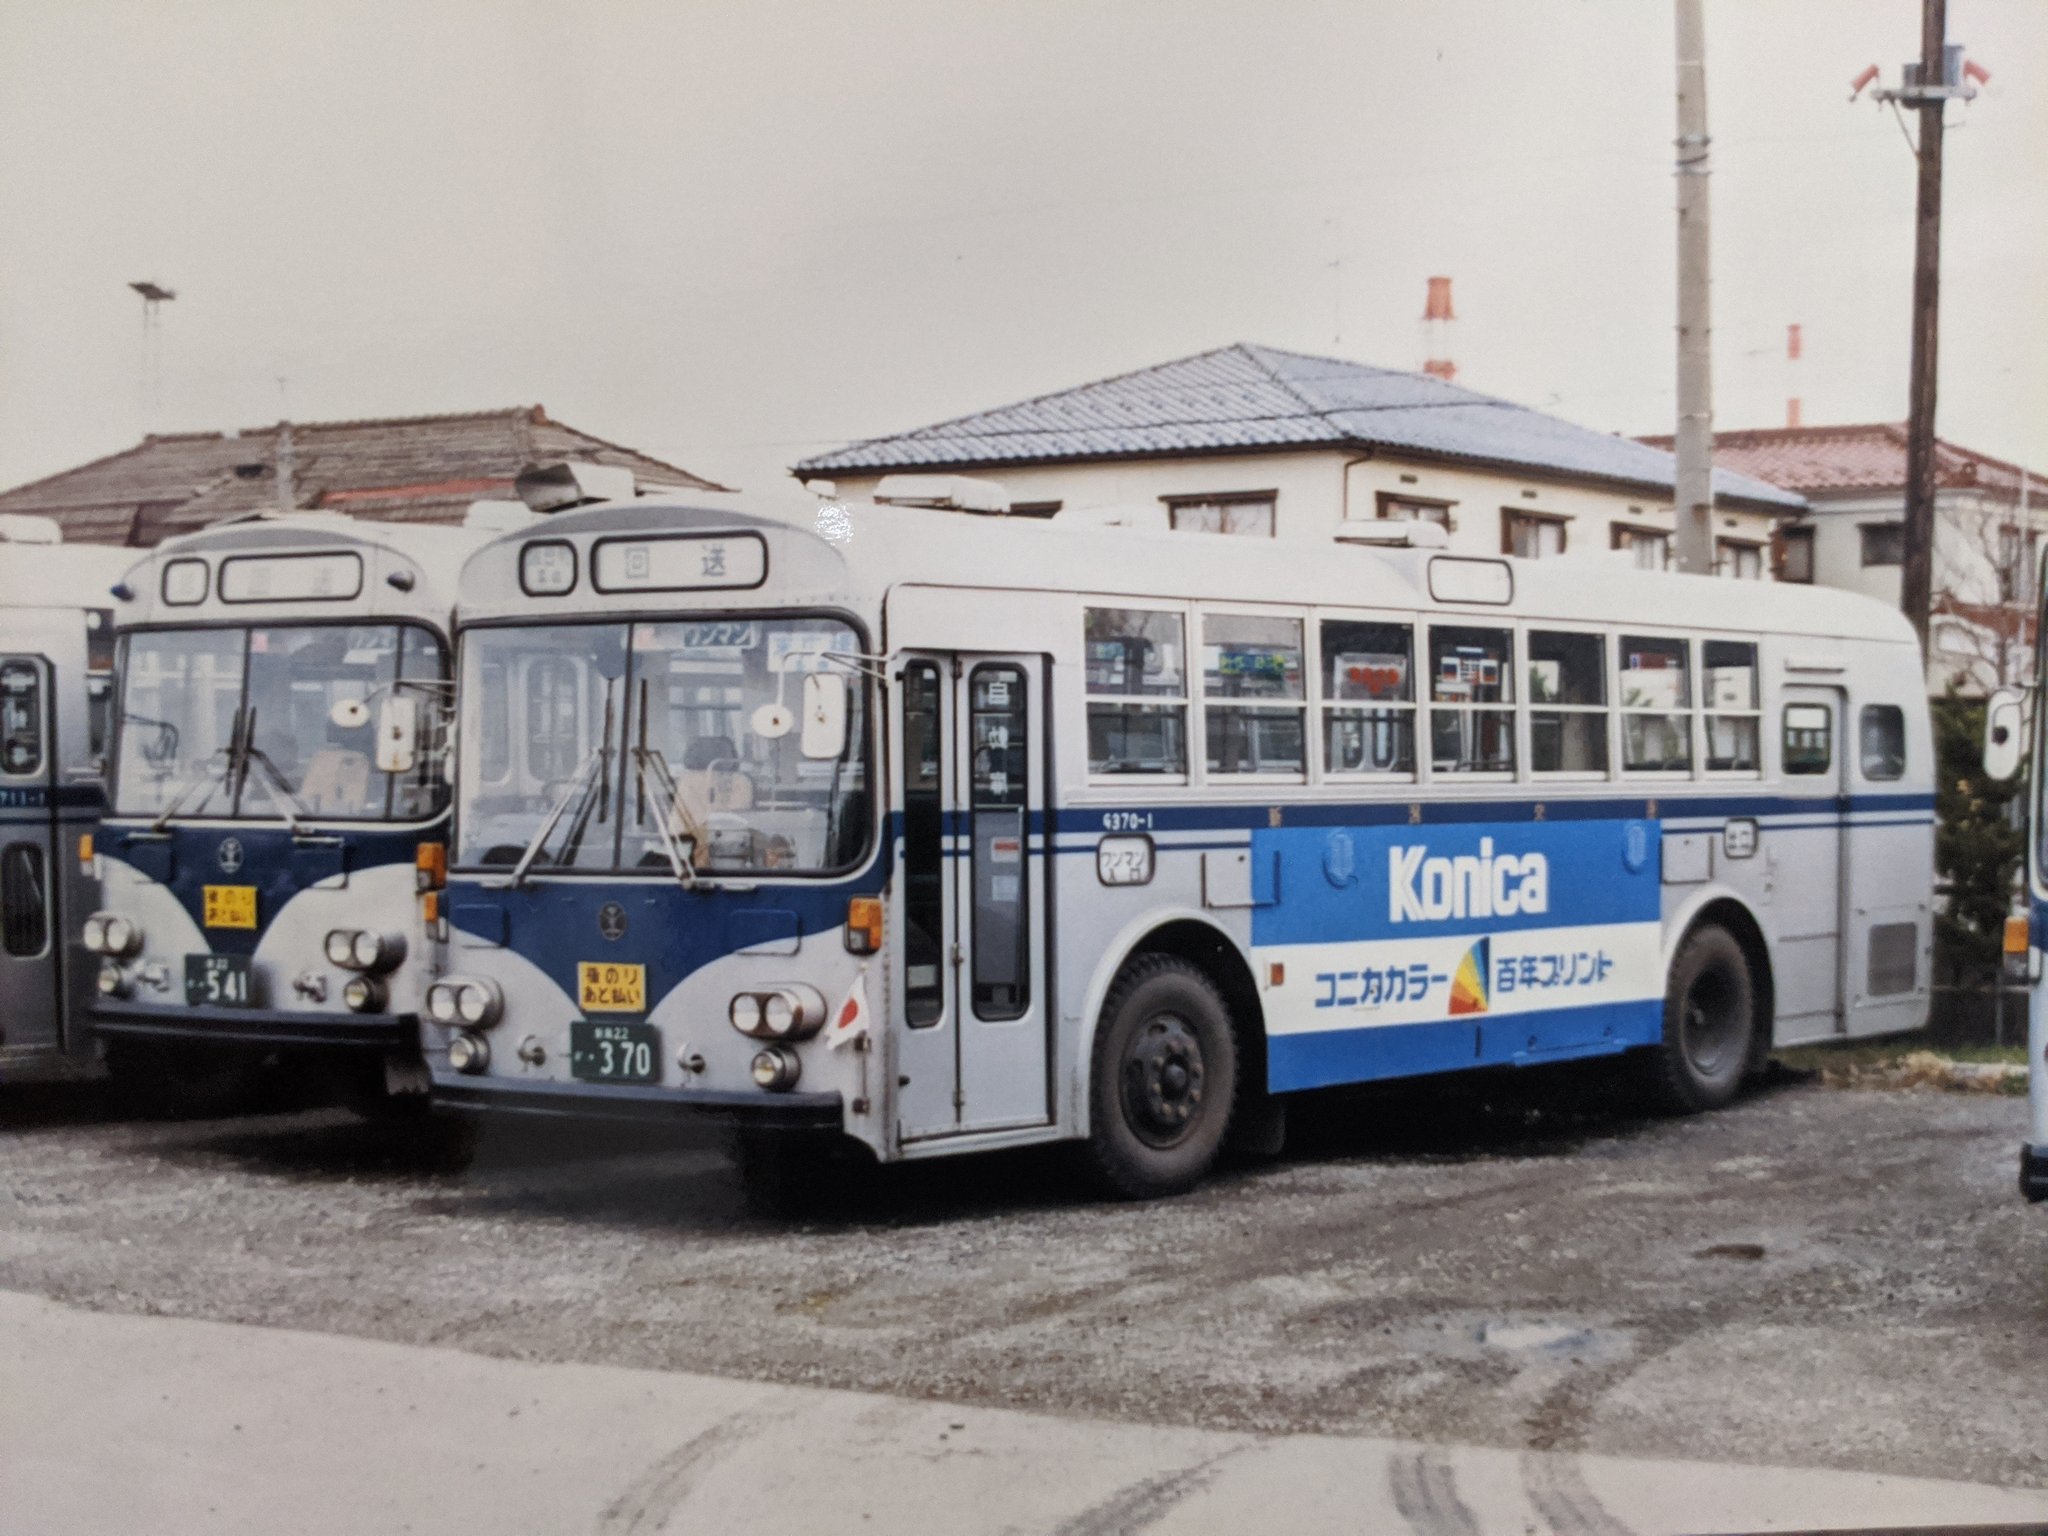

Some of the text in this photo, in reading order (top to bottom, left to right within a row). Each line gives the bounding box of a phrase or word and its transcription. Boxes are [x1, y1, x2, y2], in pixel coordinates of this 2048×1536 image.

[1389, 836, 1548, 923] Konica
[206, 969, 248, 1001] 541
[1314, 964, 1448, 1008] コニカカラー
[1496, 950, 1613, 992] 百年プリント
[599, 1040, 651, 1076] 370
